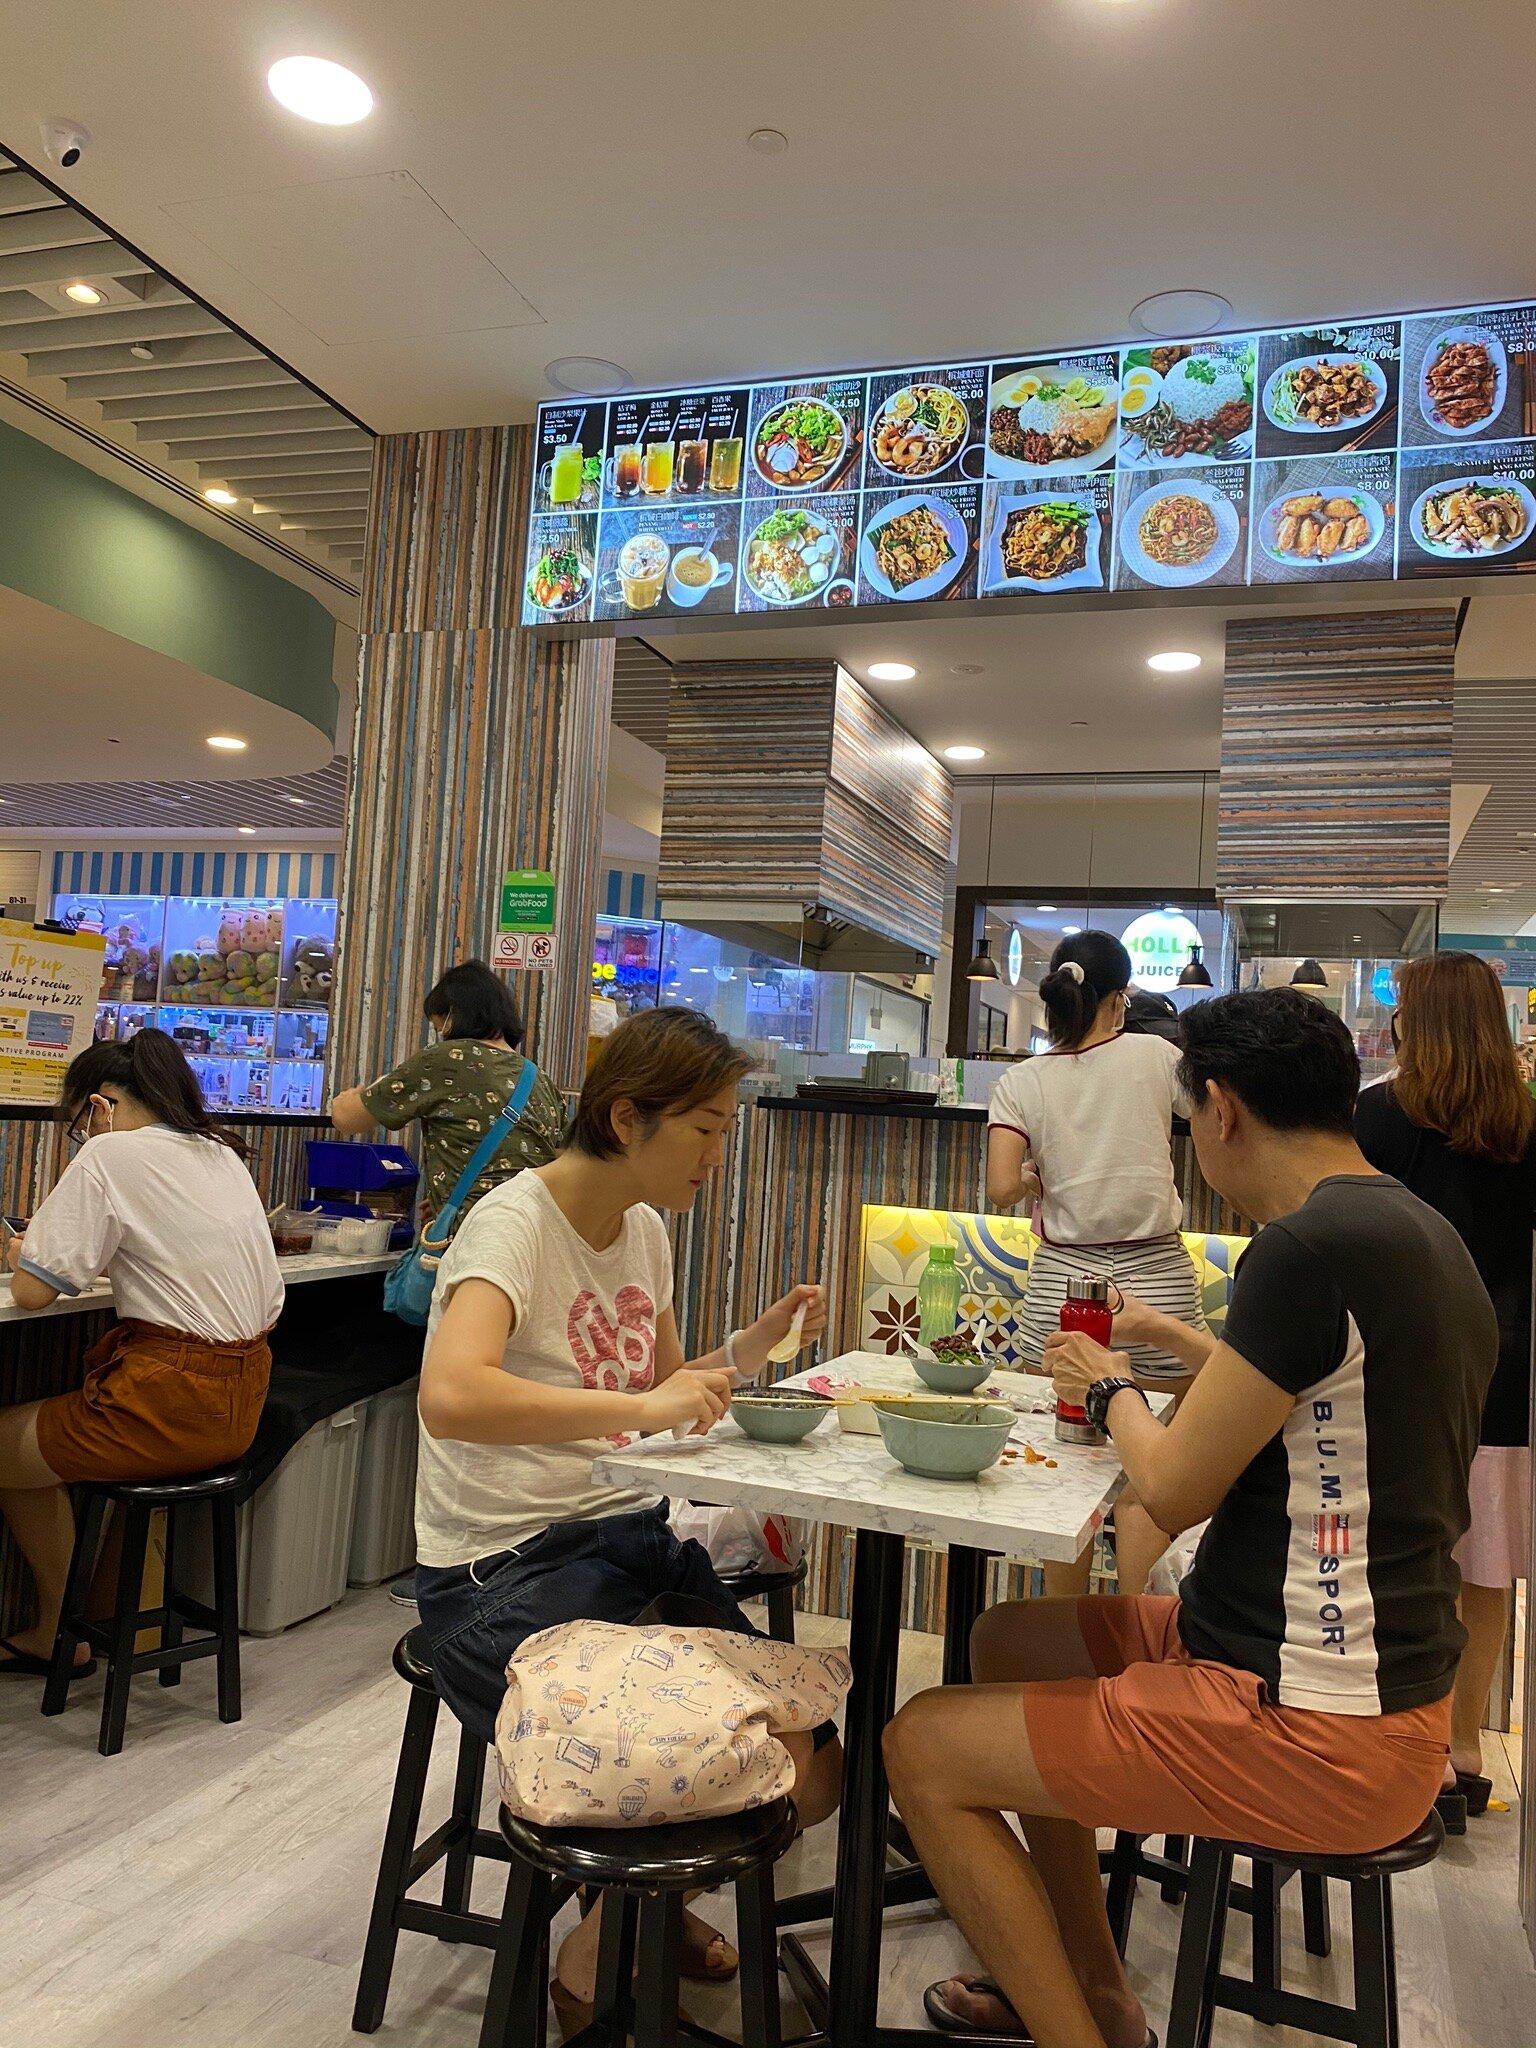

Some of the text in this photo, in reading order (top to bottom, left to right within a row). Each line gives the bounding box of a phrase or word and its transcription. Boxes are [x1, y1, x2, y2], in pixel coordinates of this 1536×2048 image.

[1354, 349, 1394, 361] $10.00
[1217, 364, 1248, 375] $5.00
[1085, 376, 1115, 387] $5.50
[955, 389, 984, 400] $5.00
[833, 398, 860, 409] $4.50
[543, 433, 567, 444] $3.50
[1492, 469, 1535, 482] $10.00
[1357, 480, 1390, 491] $8.00
[1211, 490, 1244, 501] $5.50
[1077, 499, 1109, 510] $5.50
[947, 508, 977, 519] $5.00
[827, 517, 854, 528] $4.00
[536, 534, 560, 544] $2.50
[509, 899, 548, 908] GrabFood
[6, 943, 65, 980] Top up
[1136, 965, 1185, 976] JUICE
[15, 975, 28, 985] us
[40, 980, 72, 990] receive
[8, 988, 35, 1000] value
[36, 994, 49, 1006] up
[51, 992, 61, 1003] to
[62, 994, 84, 1006] 22%
[25, 1049, 64, 1059] PROGRAM
